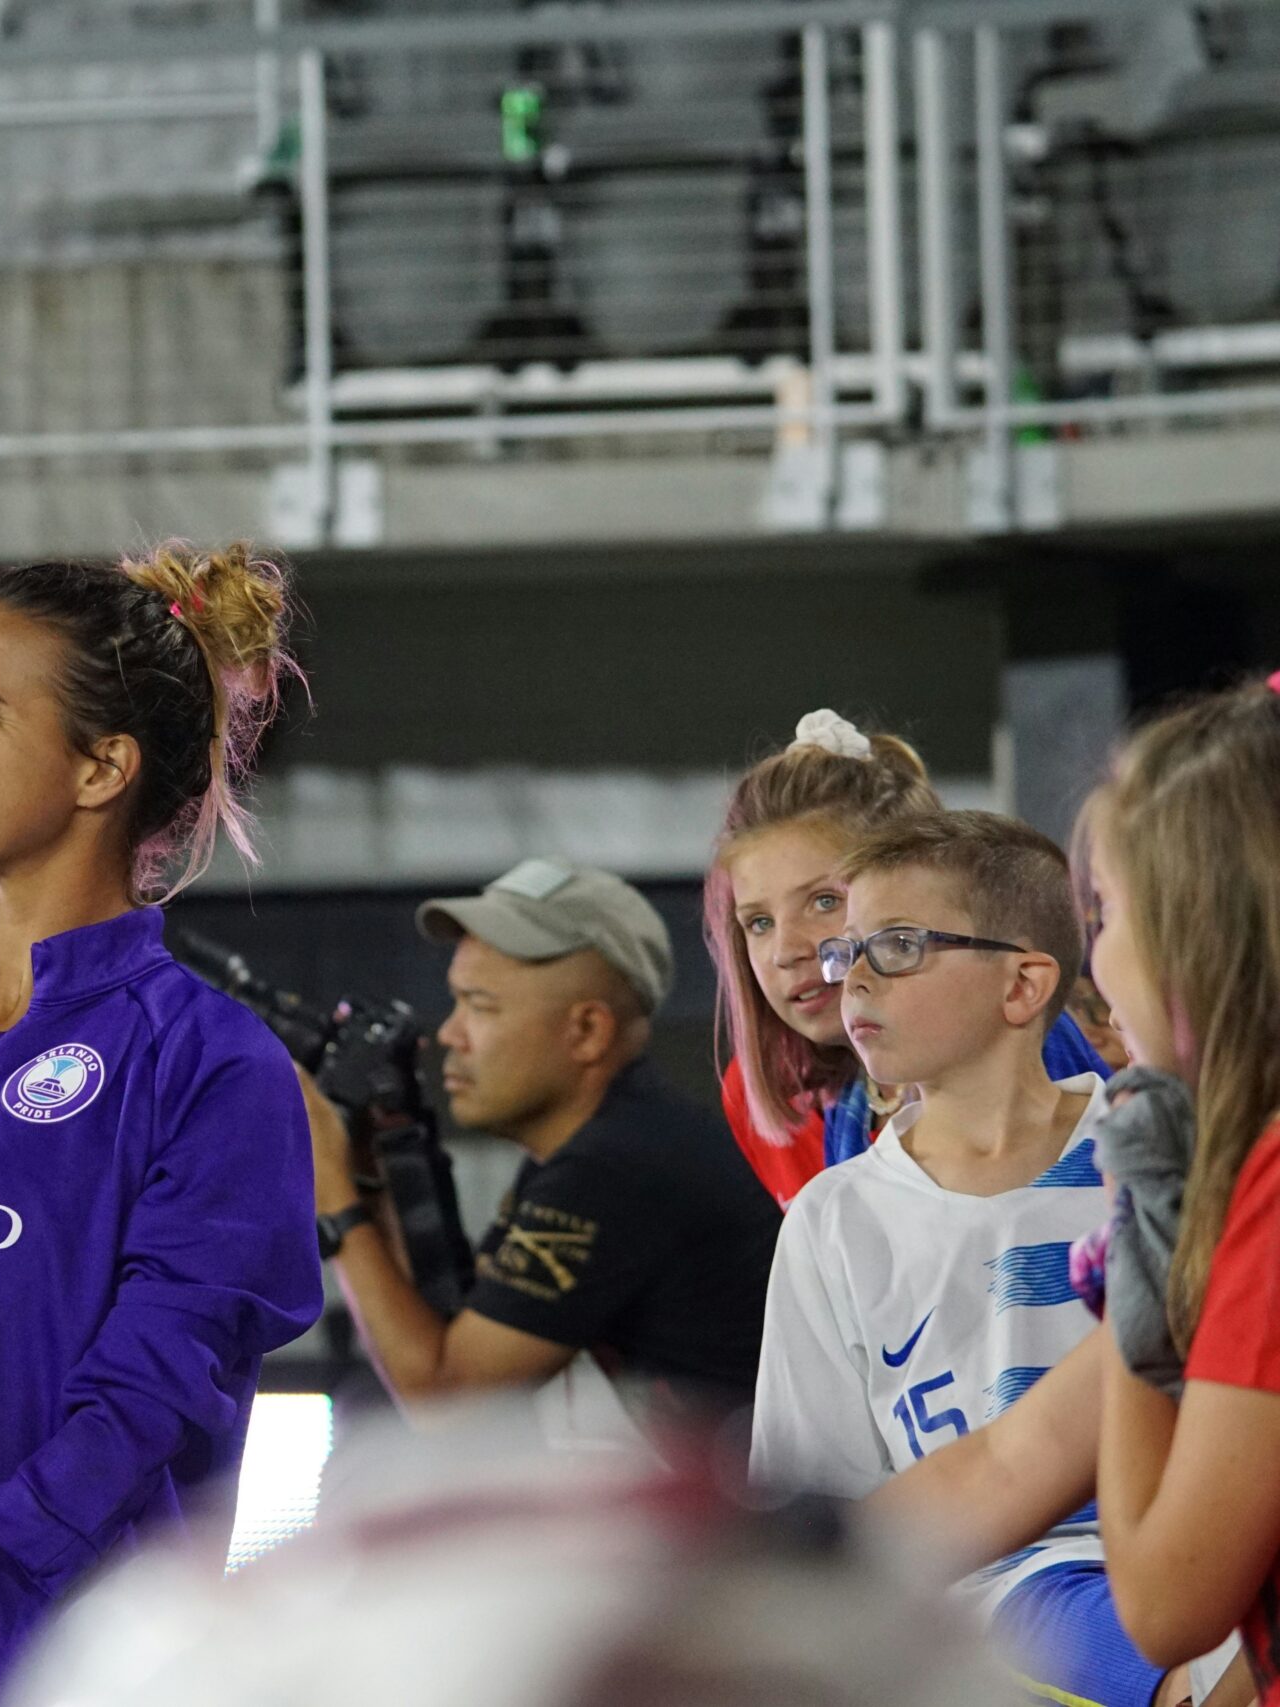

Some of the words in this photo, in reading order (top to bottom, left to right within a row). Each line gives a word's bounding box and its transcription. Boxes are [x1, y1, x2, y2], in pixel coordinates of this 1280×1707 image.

[36, 1047, 98, 1072] ORLANDO
[12, 1101, 51, 1119] PRIDE
[892, 1370, 970, 1461] 15
